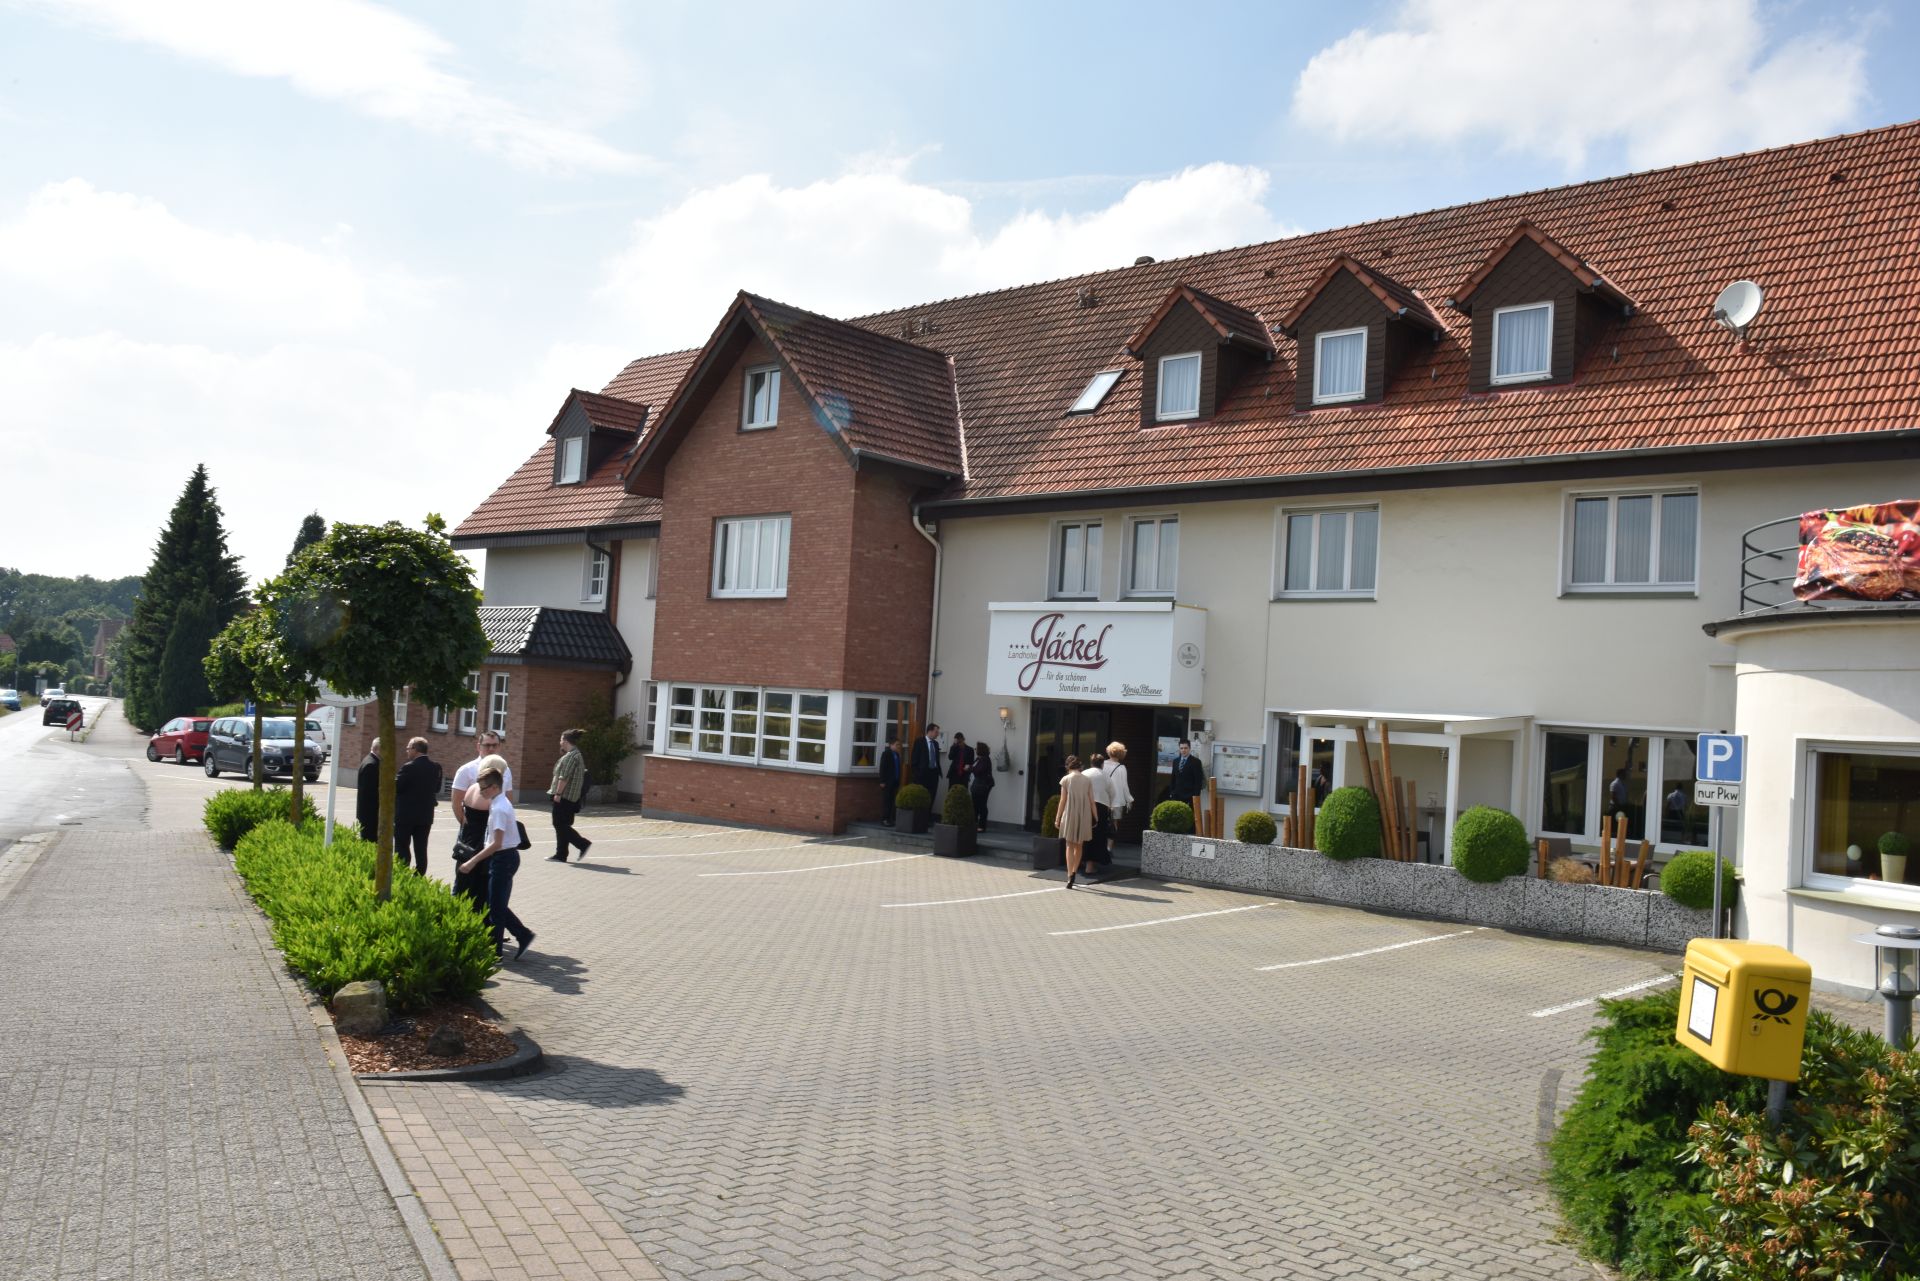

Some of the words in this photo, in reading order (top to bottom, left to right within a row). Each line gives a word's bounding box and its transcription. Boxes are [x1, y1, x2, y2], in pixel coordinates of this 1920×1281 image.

[1008, 650, 1038, 659] Landhotel
[1018, 613, 1113, 691] Jäckel
[1055, 671, 1064, 681] die
[1065, 671, 1087, 682] schönen
[1059, 682, 1081, 692] Stunden
[1081, 684, 1089, 693] im
[1089, 683, 1107, 694] Leben
[1121, 683, 1141, 696] König
[1706, 738, 1734, 779] P
[1698, 790, 1715, 799] nur
[1717, 786, 1738, 801] Pkw
